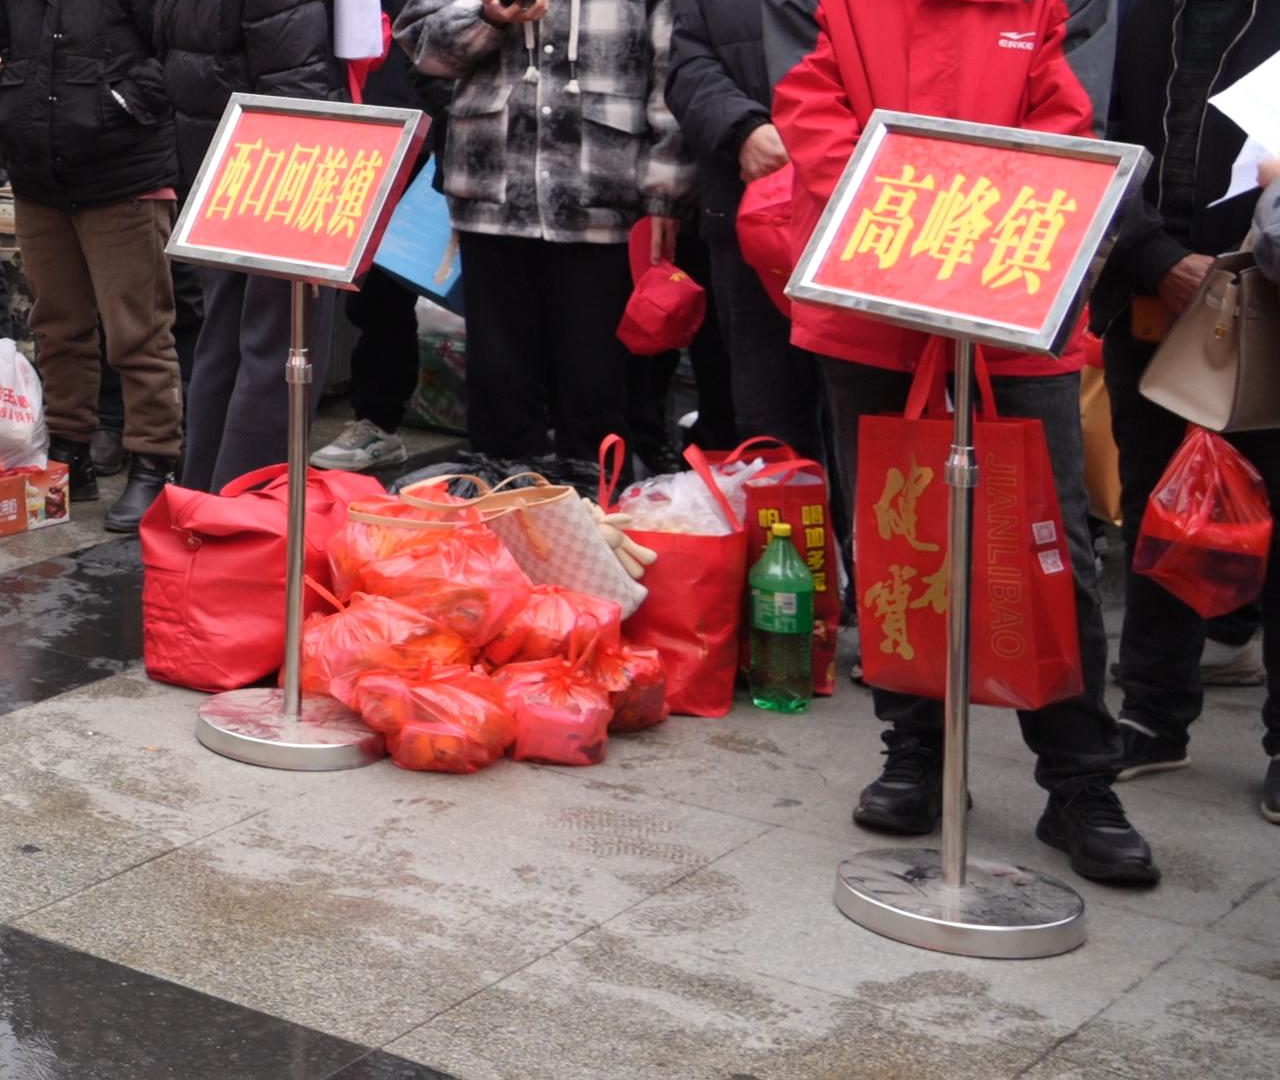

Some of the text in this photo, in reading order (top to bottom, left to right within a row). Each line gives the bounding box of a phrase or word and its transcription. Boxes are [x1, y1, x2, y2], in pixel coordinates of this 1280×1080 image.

[998, 39, 1035, 51] ERKE
[205, 137, 384, 239] 西口回族镇
[840, 164, 1077, 296] 高峰镇
[986, 454, 1027, 660] JIANLIBAO
